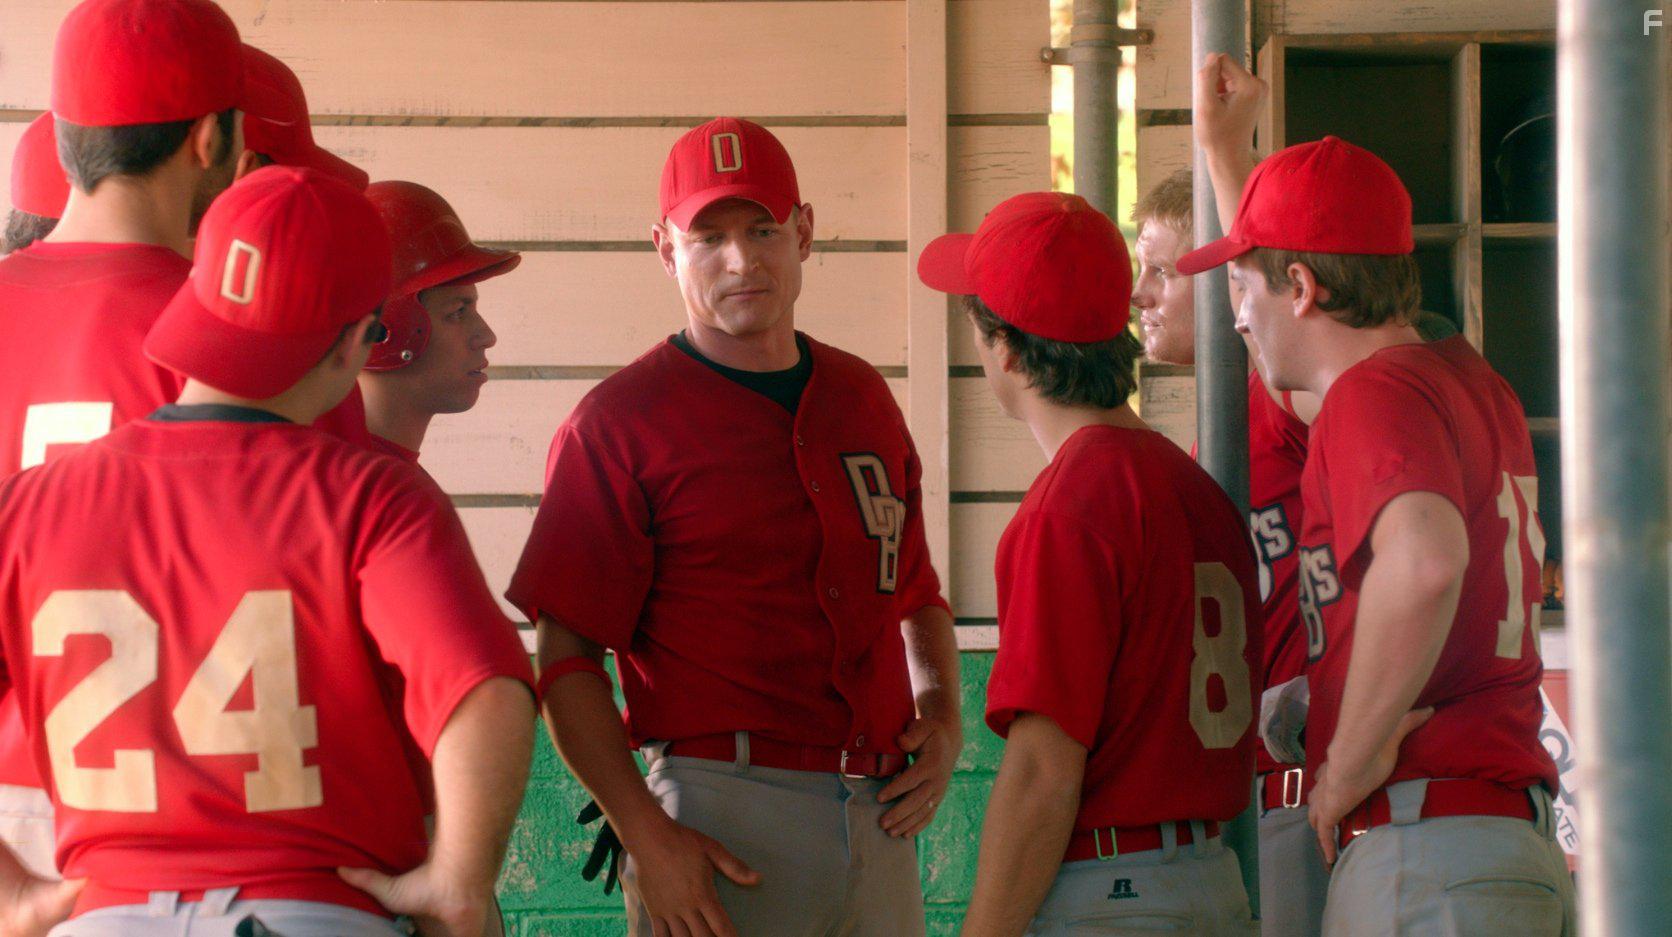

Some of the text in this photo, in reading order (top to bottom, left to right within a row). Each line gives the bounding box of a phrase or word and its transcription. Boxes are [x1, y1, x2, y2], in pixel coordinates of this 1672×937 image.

[711, 132, 743, 174] D
[220, 239, 262, 305] D
[31, 590, 324, 813] 24
[1189, 562, 1253, 749] 8
